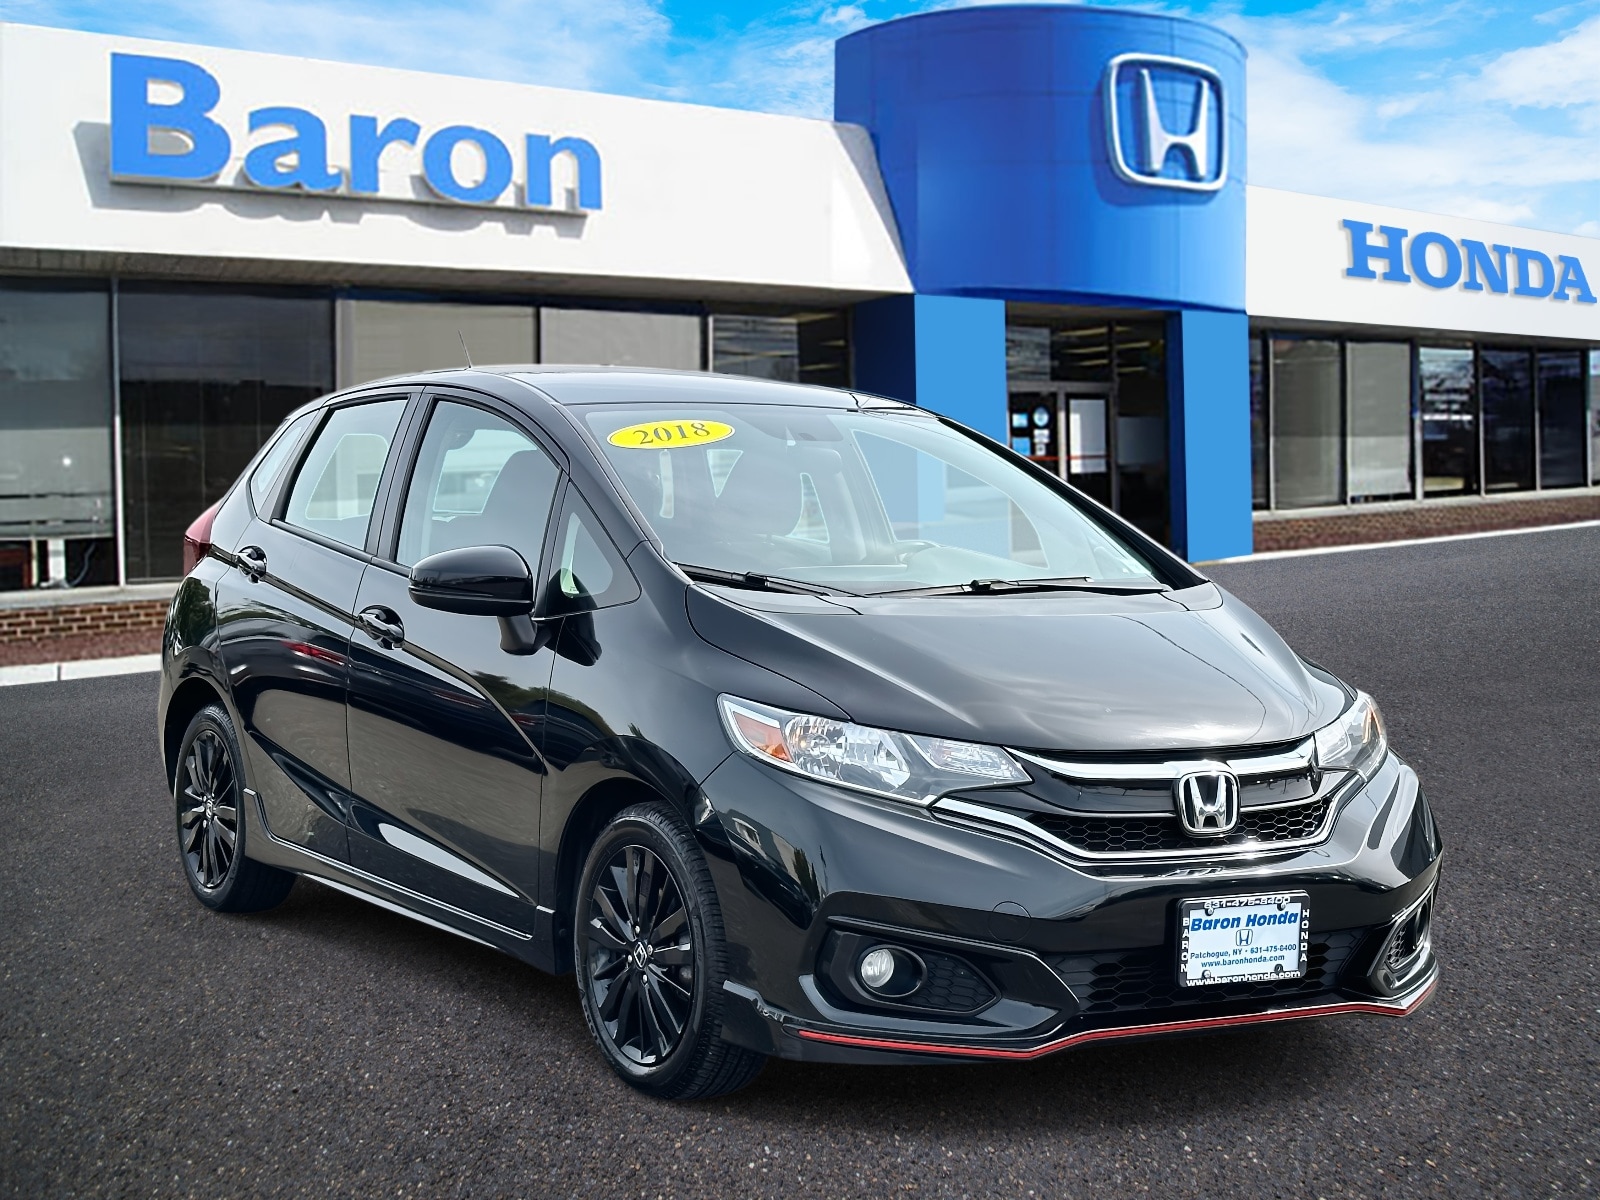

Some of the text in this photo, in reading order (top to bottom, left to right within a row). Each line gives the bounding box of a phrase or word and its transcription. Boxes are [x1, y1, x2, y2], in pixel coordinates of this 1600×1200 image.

[110, 52, 602, 210] Baron
[1342, 218, 1598, 304] HONDA
[633, 422, 710, 445] 2018
[1190, 911, 1299, 931] Baron Honda
[1181, 917, 1189, 973] BARON
[1300, 909, 1310, 962] HONDA
[1190, 950, 1230, 960] Patchogue,
[1201, 954, 1285, 968] www.baronhonda.com
[1186, 970, 1301, 987] www.baronhonda.com
